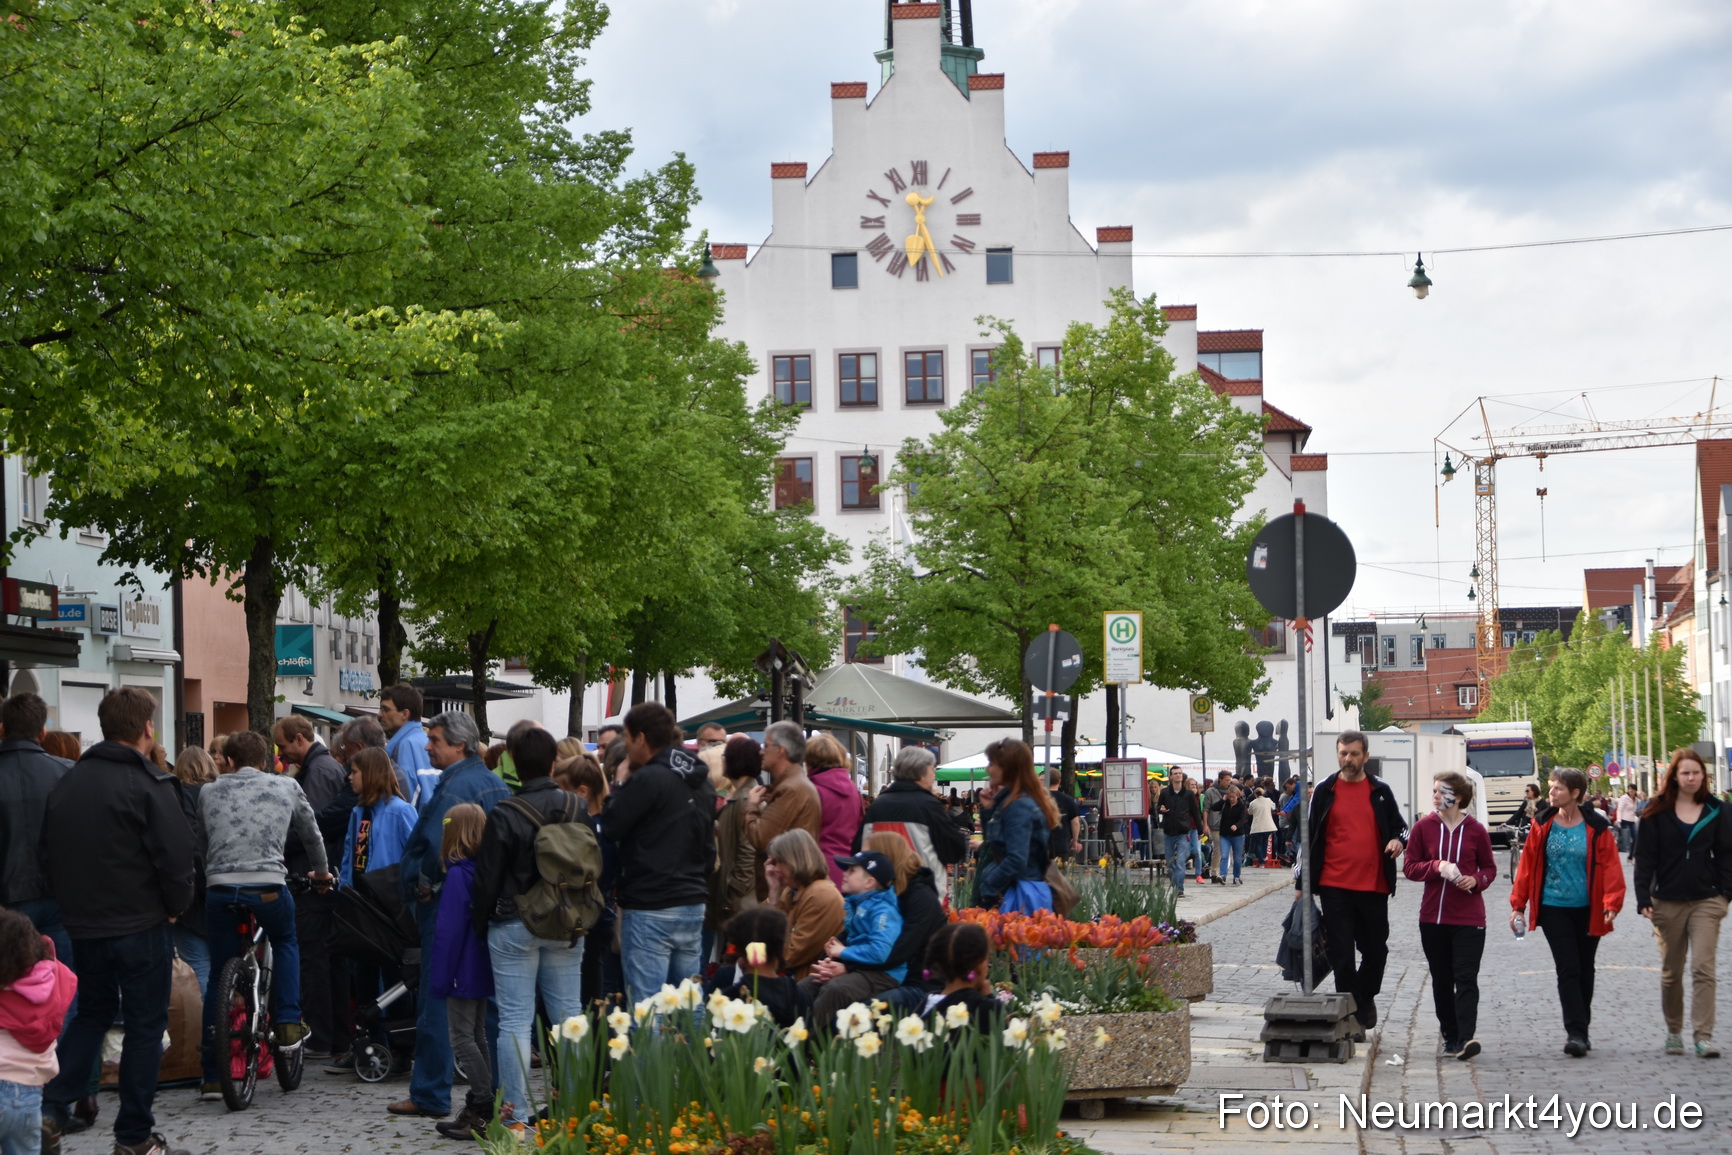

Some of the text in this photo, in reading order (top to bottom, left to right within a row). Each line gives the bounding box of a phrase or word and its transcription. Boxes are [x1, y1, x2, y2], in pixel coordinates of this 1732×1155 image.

[58, 608, 82, 618] u.de
[1116, 622, 1130, 638] H
[277, 656, 312, 668] chlöffel
